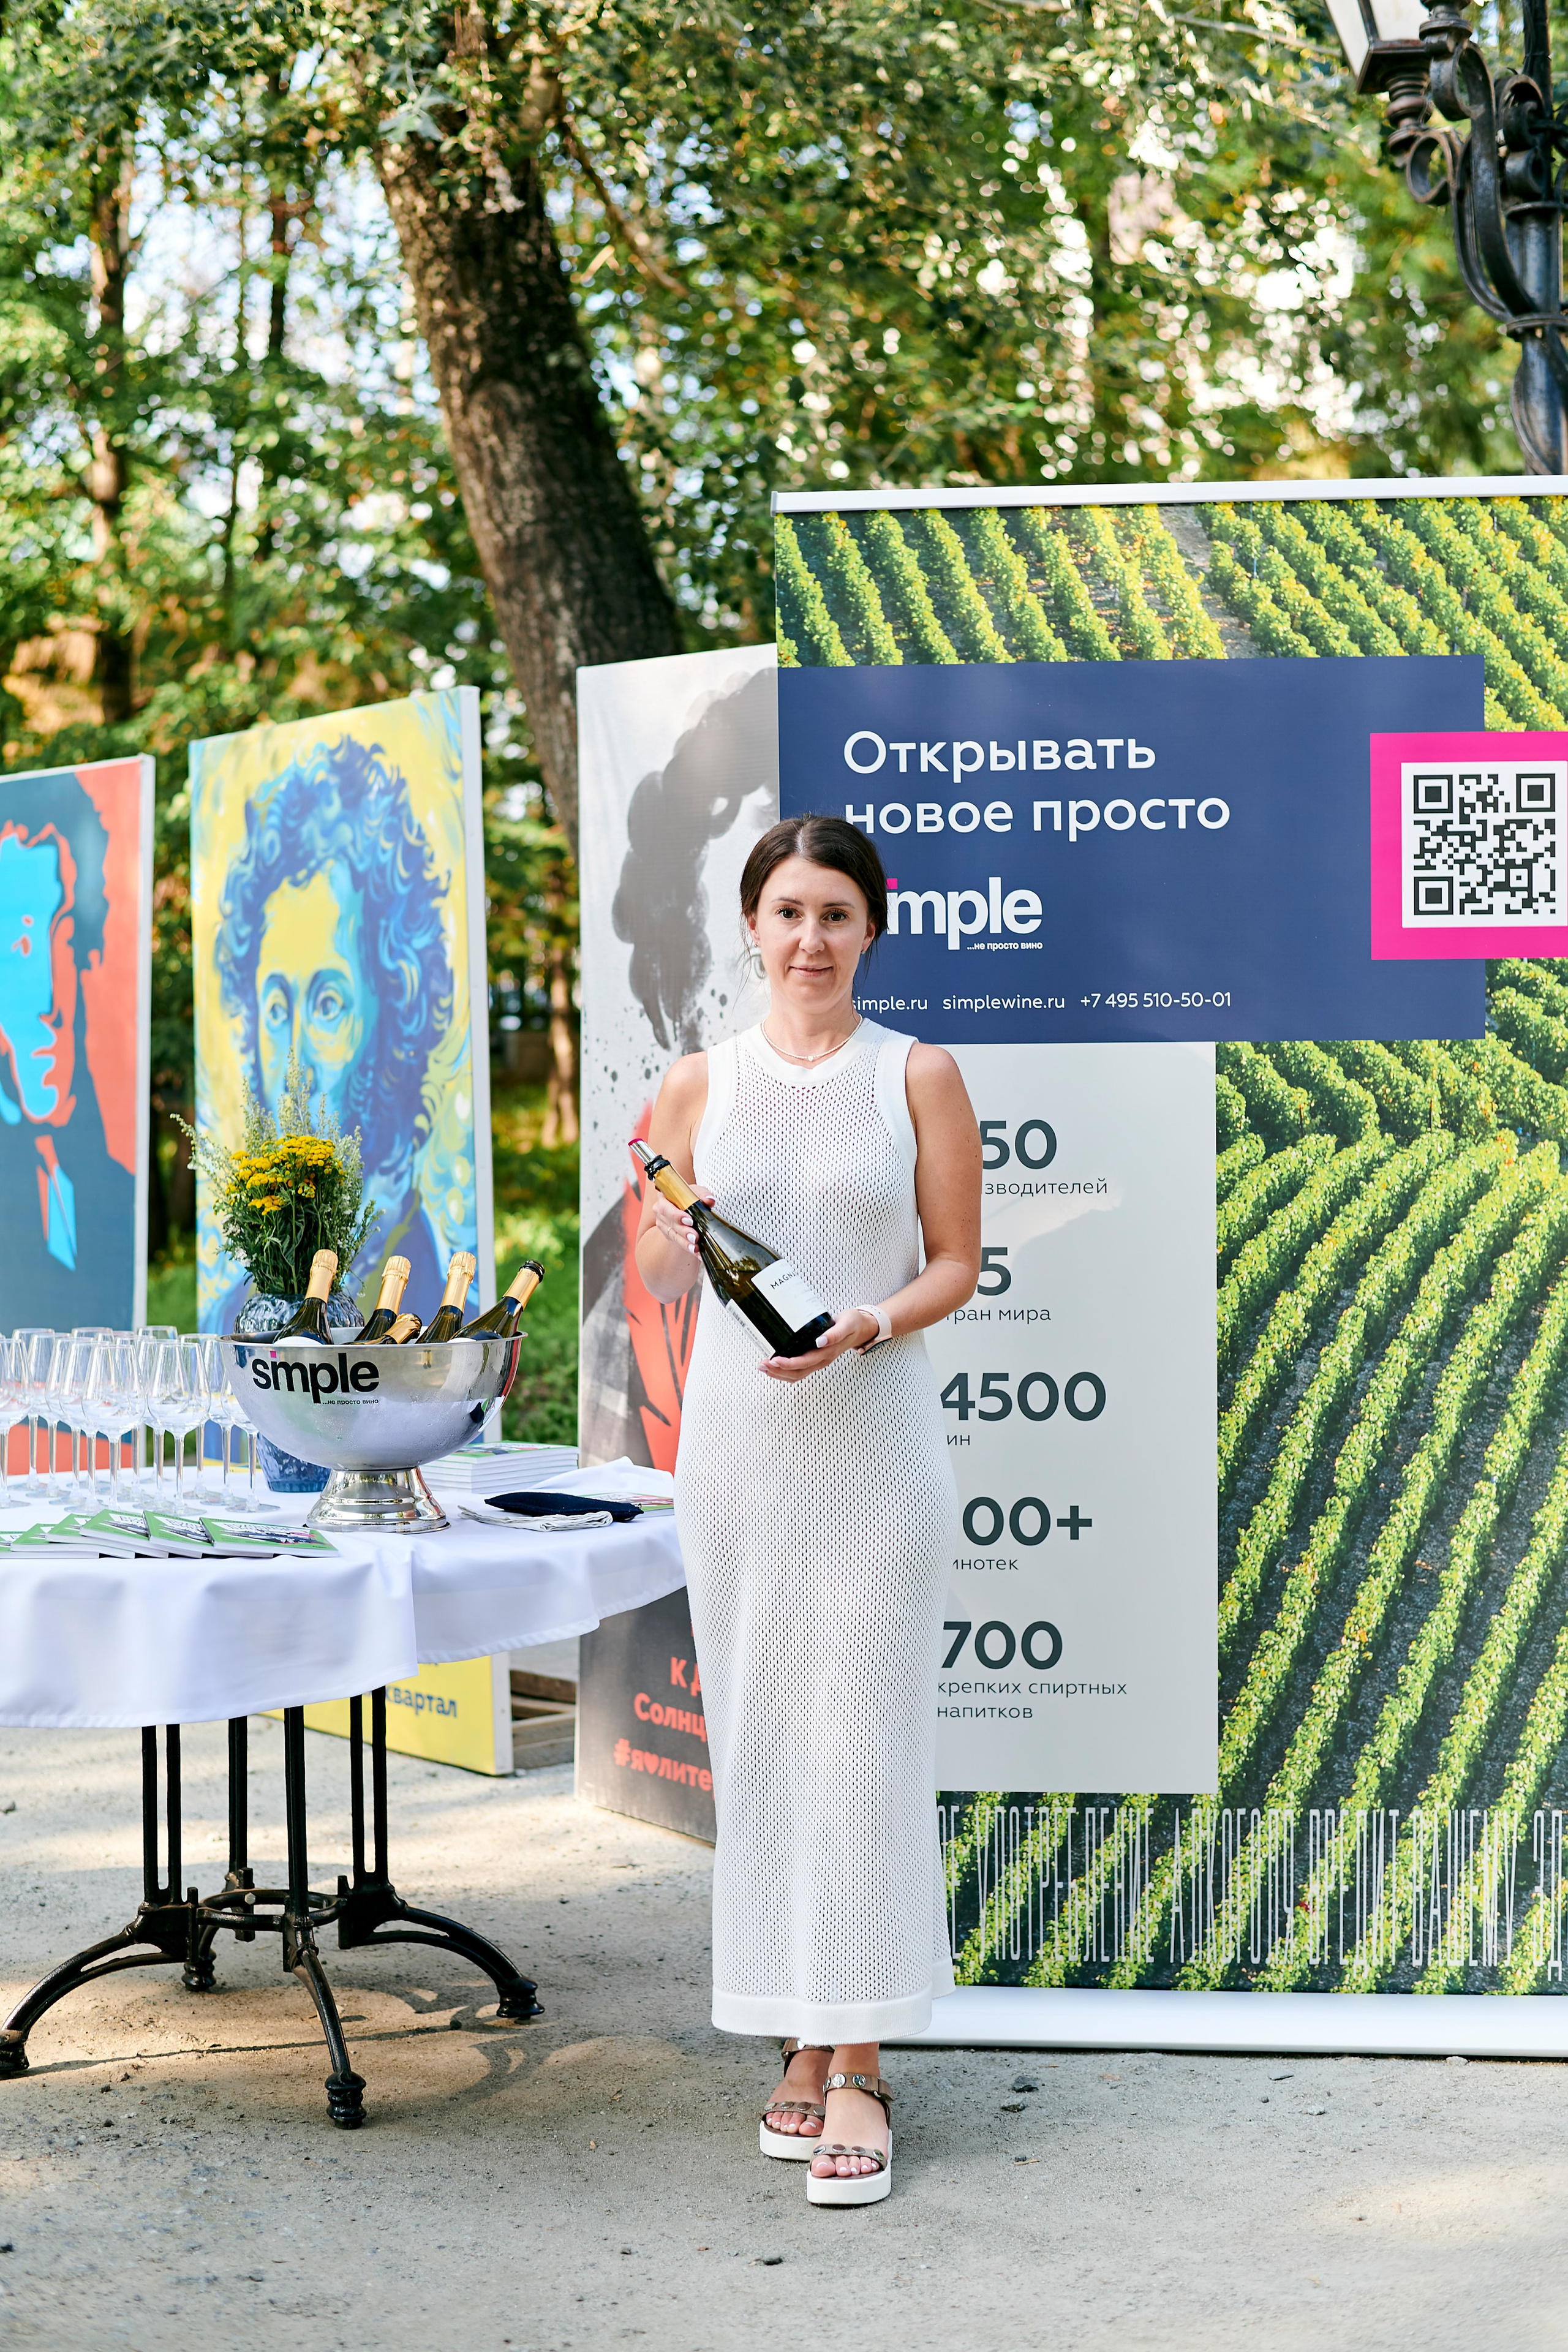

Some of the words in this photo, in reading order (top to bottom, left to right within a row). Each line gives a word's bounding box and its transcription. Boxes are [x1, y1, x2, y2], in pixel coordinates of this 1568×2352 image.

[843, 731, 1156, 783] Открывать
[845, 801, 1013, 834] новое
[1033, 797, 1230, 842] просто
[987, 942, 1019, 952] просто
[943, 994, 1065, 1013] simplewine.ru
[1080, 993, 1101, 1008] +7
[1105, 992, 1139, 1008] 495
[1143, 992, 1231, 1008] 510-50-01
[981, 1119, 1057, 1170] 50
[984, 1178, 1108, 1197] зводителей
[977, 1246, 1012, 1296] 5
[998, 1309, 1052, 1325] мира
[252, 1350, 380, 1404] simple
[940, 1371, 1106, 1422] 4500
[962, 1496, 1093, 1546] 00+
[941, 1621, 1063, 1670] 700
[385, 1686, 458, 1719] квартал
[937, 1706, 1033, 1719] напитков
[938, 1682, 1022, 1697] крепких
[1028, 1682, 1128, 1697] спиртных
[975, 1806, 1155, 1963] УПОТРЕБЛЕНИЕ
[1169, 1807, 1294, 1965] АЛКОГОЛЯ
[1309, 1808, 1400, 1978] ВРЕДИТ
[1412, 1809, 1518, 1967] ВАШЕМУ
[1532, 1809, 1568, 1982] ЗД
